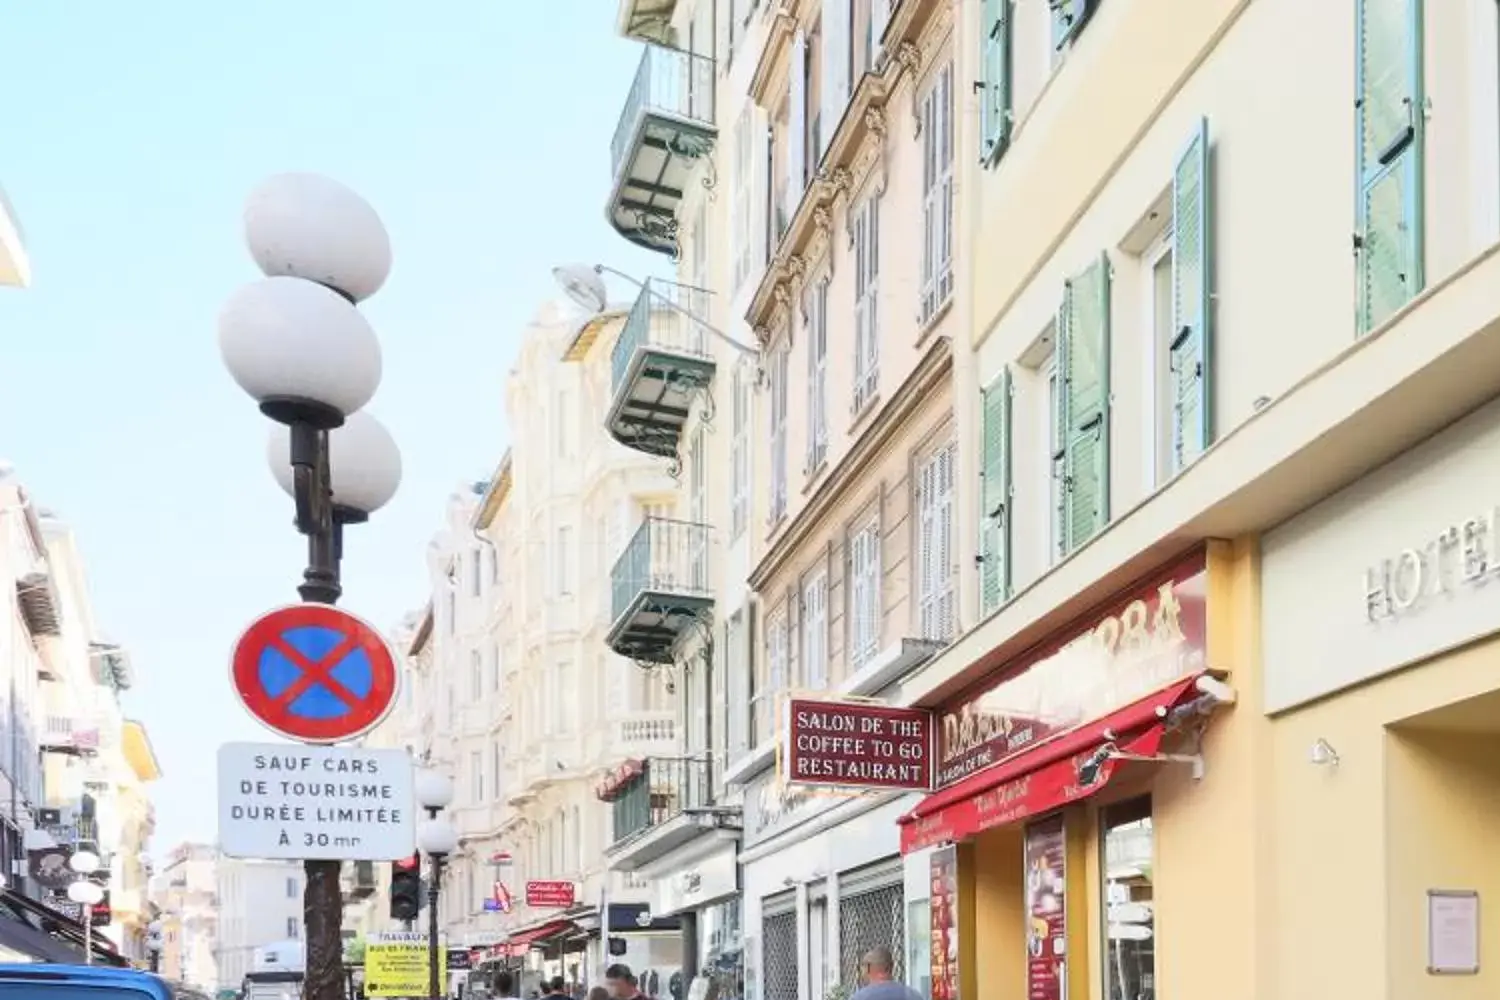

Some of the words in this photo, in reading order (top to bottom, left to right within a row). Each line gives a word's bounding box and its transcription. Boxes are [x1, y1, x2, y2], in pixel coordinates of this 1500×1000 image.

[797, 711, 855, 731] SALON
[861, 717, 883, 735] DE
[797, 735, 865, 755] COFFEE
[871, 739, 893, 757] TO
[899, 743, 923, 760] GO
[254, 756, 312, 771] SAUF
[323, 758, 378, 773] CARS
[797, 757, 923, 782] RESTAURANT
[240, 781, 267, 795] DE
[280, 781, 392, 799] TOURISME
[231, 803, 305, 821] DURÉE
[316, 807, 401, 824] LIMITÉE
[278, 829, 291, 846] À
